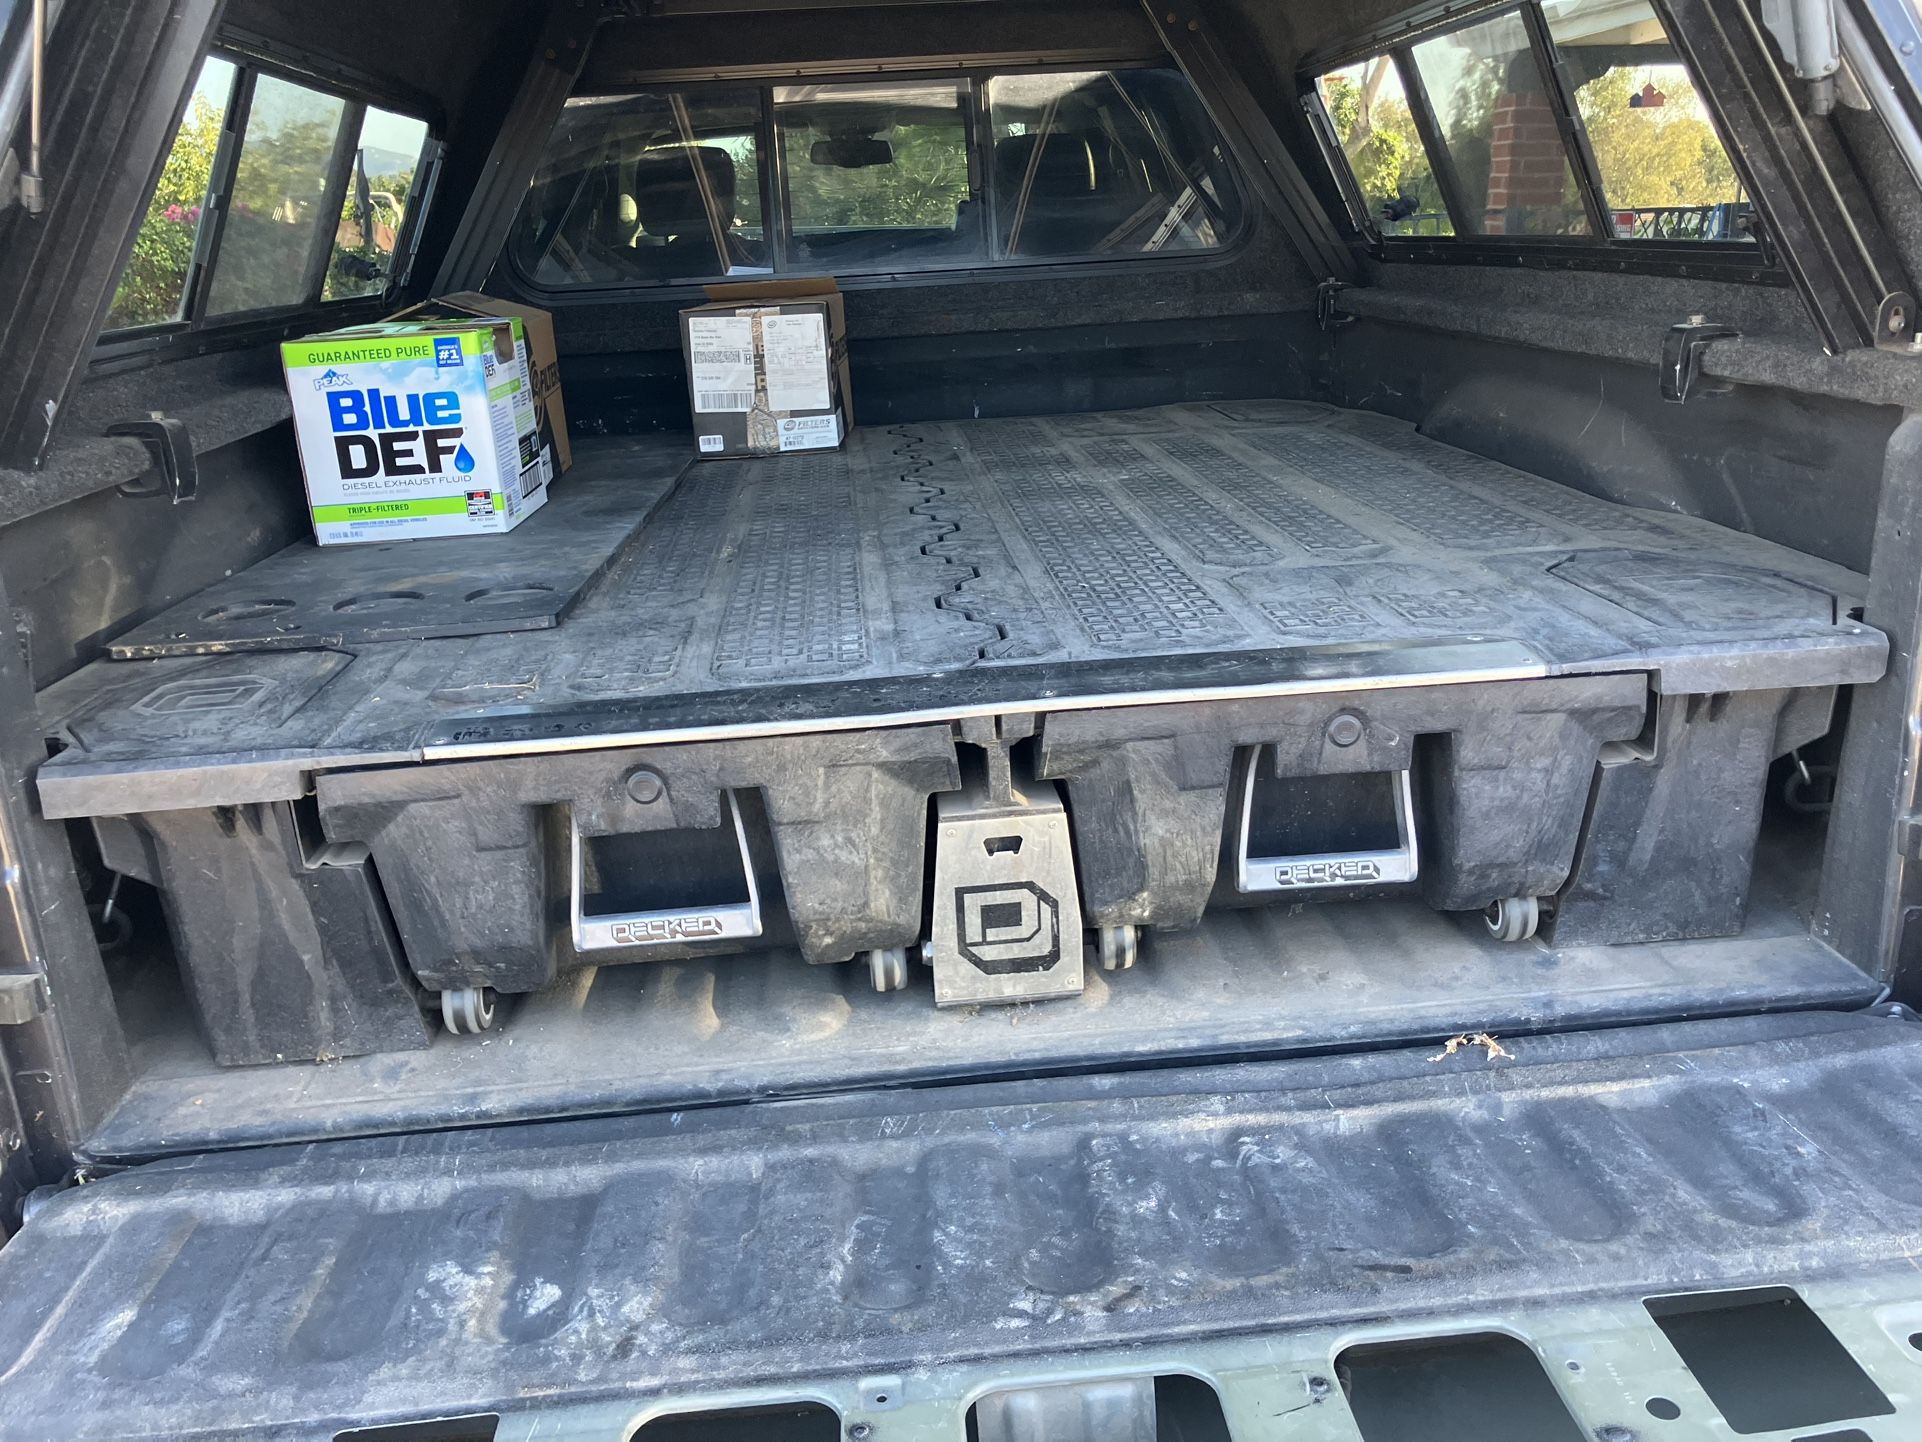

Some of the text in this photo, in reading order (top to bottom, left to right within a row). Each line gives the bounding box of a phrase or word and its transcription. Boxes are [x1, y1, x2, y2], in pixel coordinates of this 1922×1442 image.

[308, 345, 430, 364] GUARANTEED PURE
[438, 349, 459, 360] #1
[313, 373, 353, 391] PEAK
[326, 388, 462, 433] Blue
[333, 427, 464, 480] DEF
[342, 475, 472, 490] DIESEL EXHAUST FLUID
[347, 504, 409, 514] TRIPLE-FILTERED
[1275, 861, 1380, 886] DECKED
[611, 916, 722, 943] DECKED
